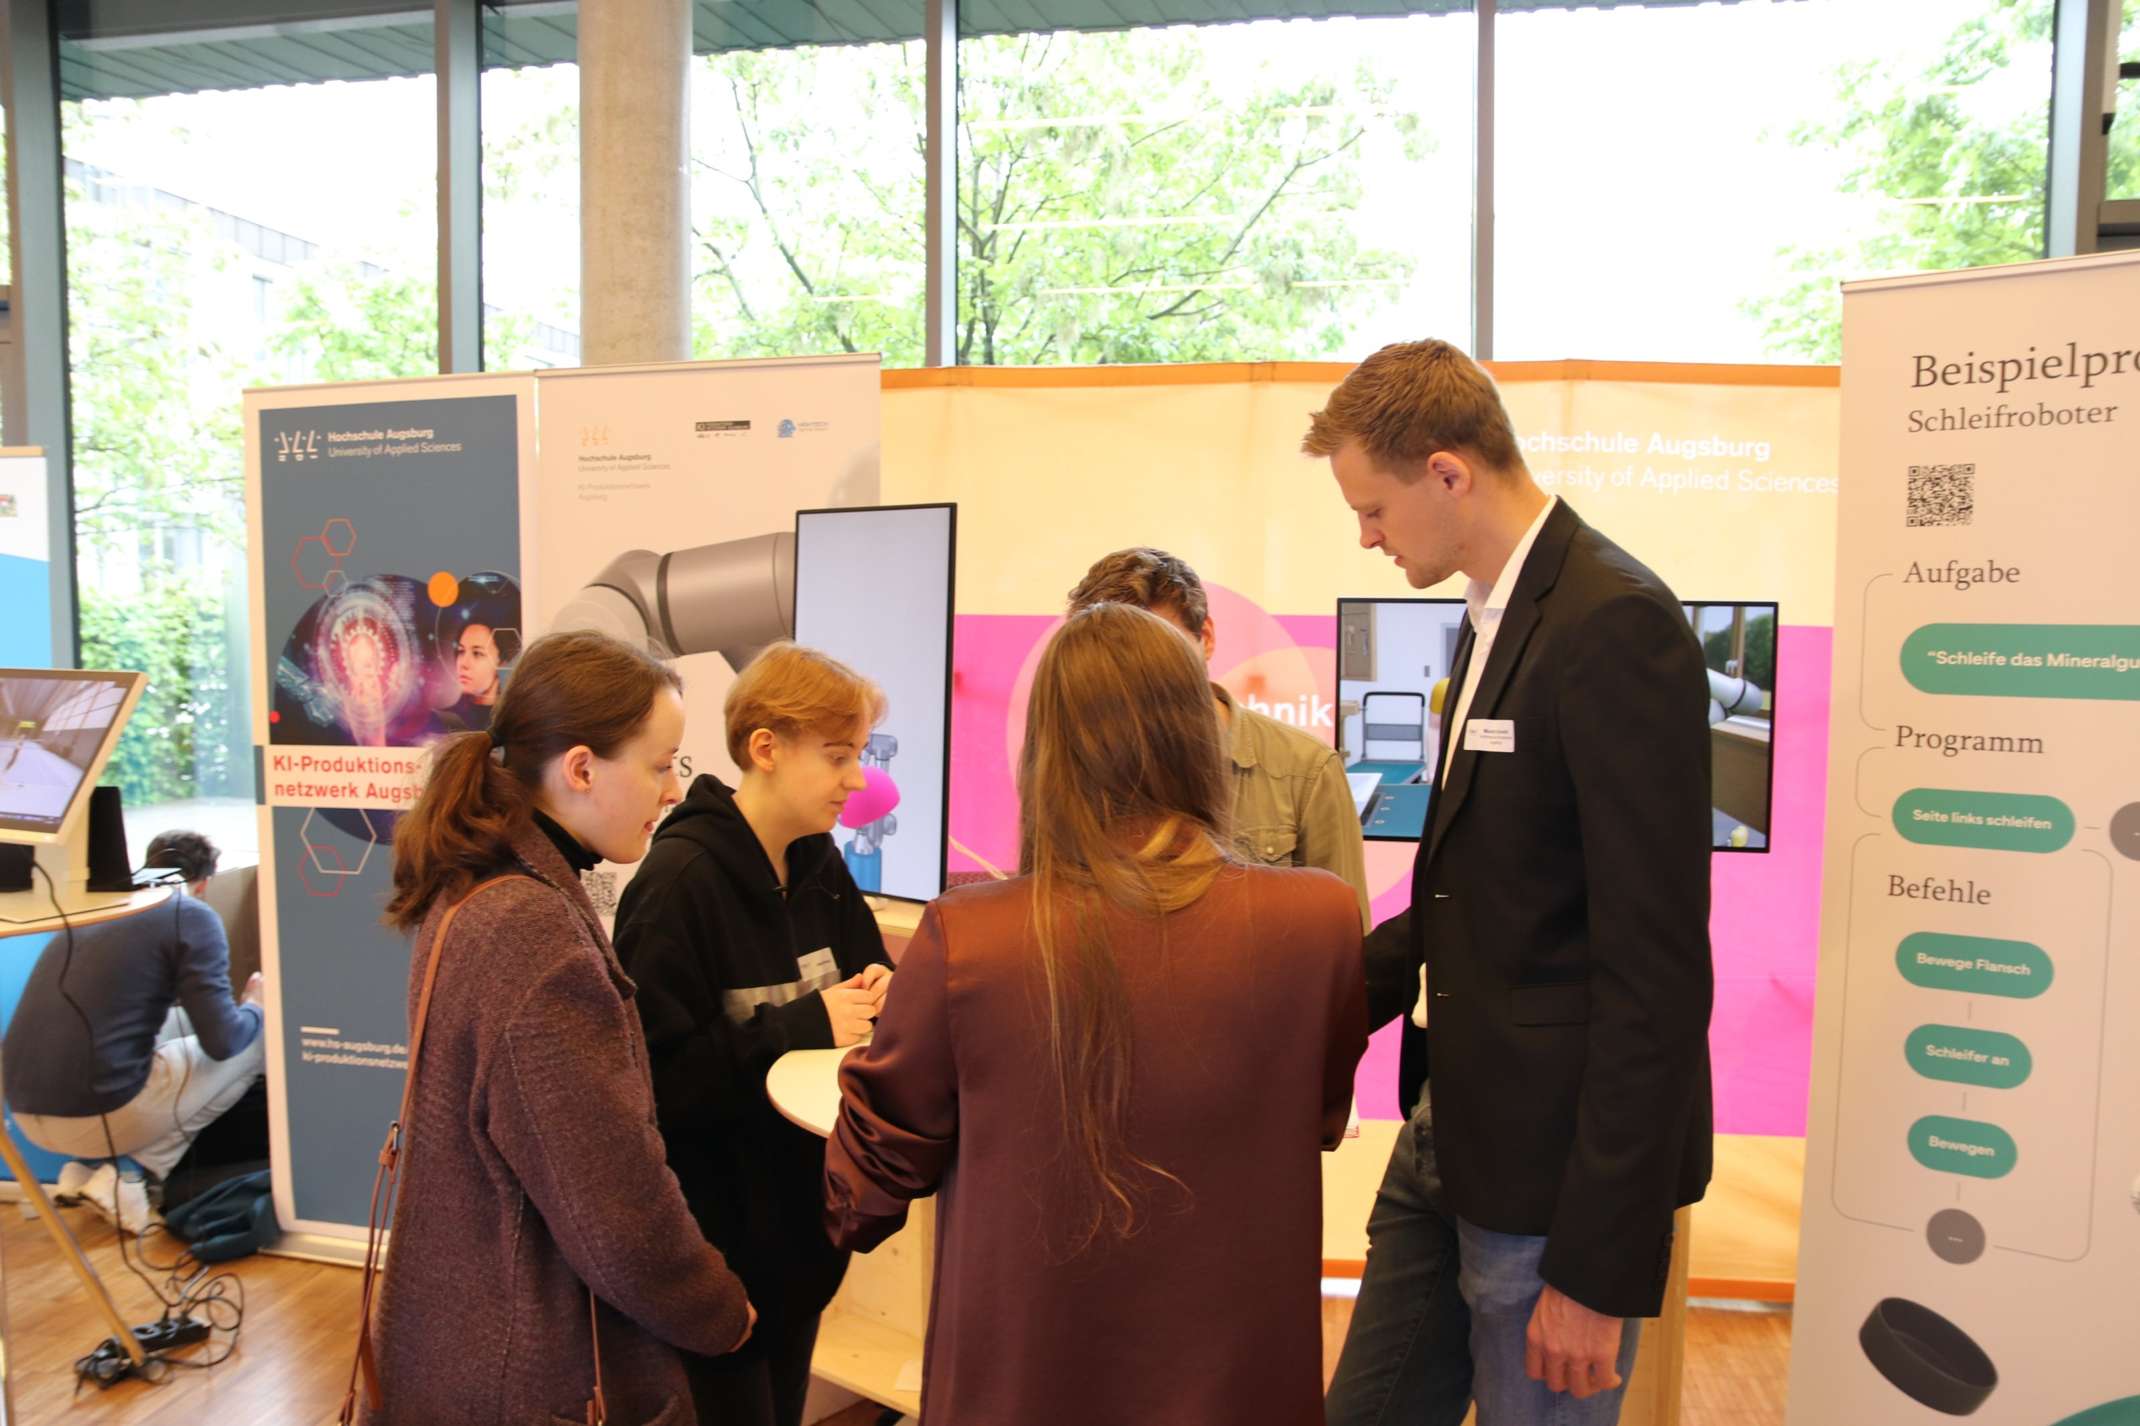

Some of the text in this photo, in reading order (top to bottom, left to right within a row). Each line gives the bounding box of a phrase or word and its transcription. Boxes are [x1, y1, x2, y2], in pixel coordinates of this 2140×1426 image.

[1907, 402, 2119, 433] Schleifroboter
[328, 427, 434, 443] Hochschule Augsburg
[1514, 430, 1772, 463] ochschule Augsburg
[384, 442, 419, 457] Applied
[420, 441, 463, 453] Sciences
[1532, 467, 1839, 495] versity of Applied Sciences
[1902, 559, 2021, 591] Aufgabe
[2010, 653, 2043, 668] das
[1246, 693, 1334, 727] hnik
[1895, 725, 2045, 758] Programm
[273, 755, 422, 774] KI-Produktions-
[274, 782, 424, 803] netzwerk Augsb
[1912, 809, 2053, 830] Seite links schleifen
[1887, 873, 1992, 905] Befehle
[1916, 952, 2032, 976] Bewege Flansch
[1925, 1044, 2011, 1067] Schleifer an
[1928, 1135, 1996, 1157] Bewegen
